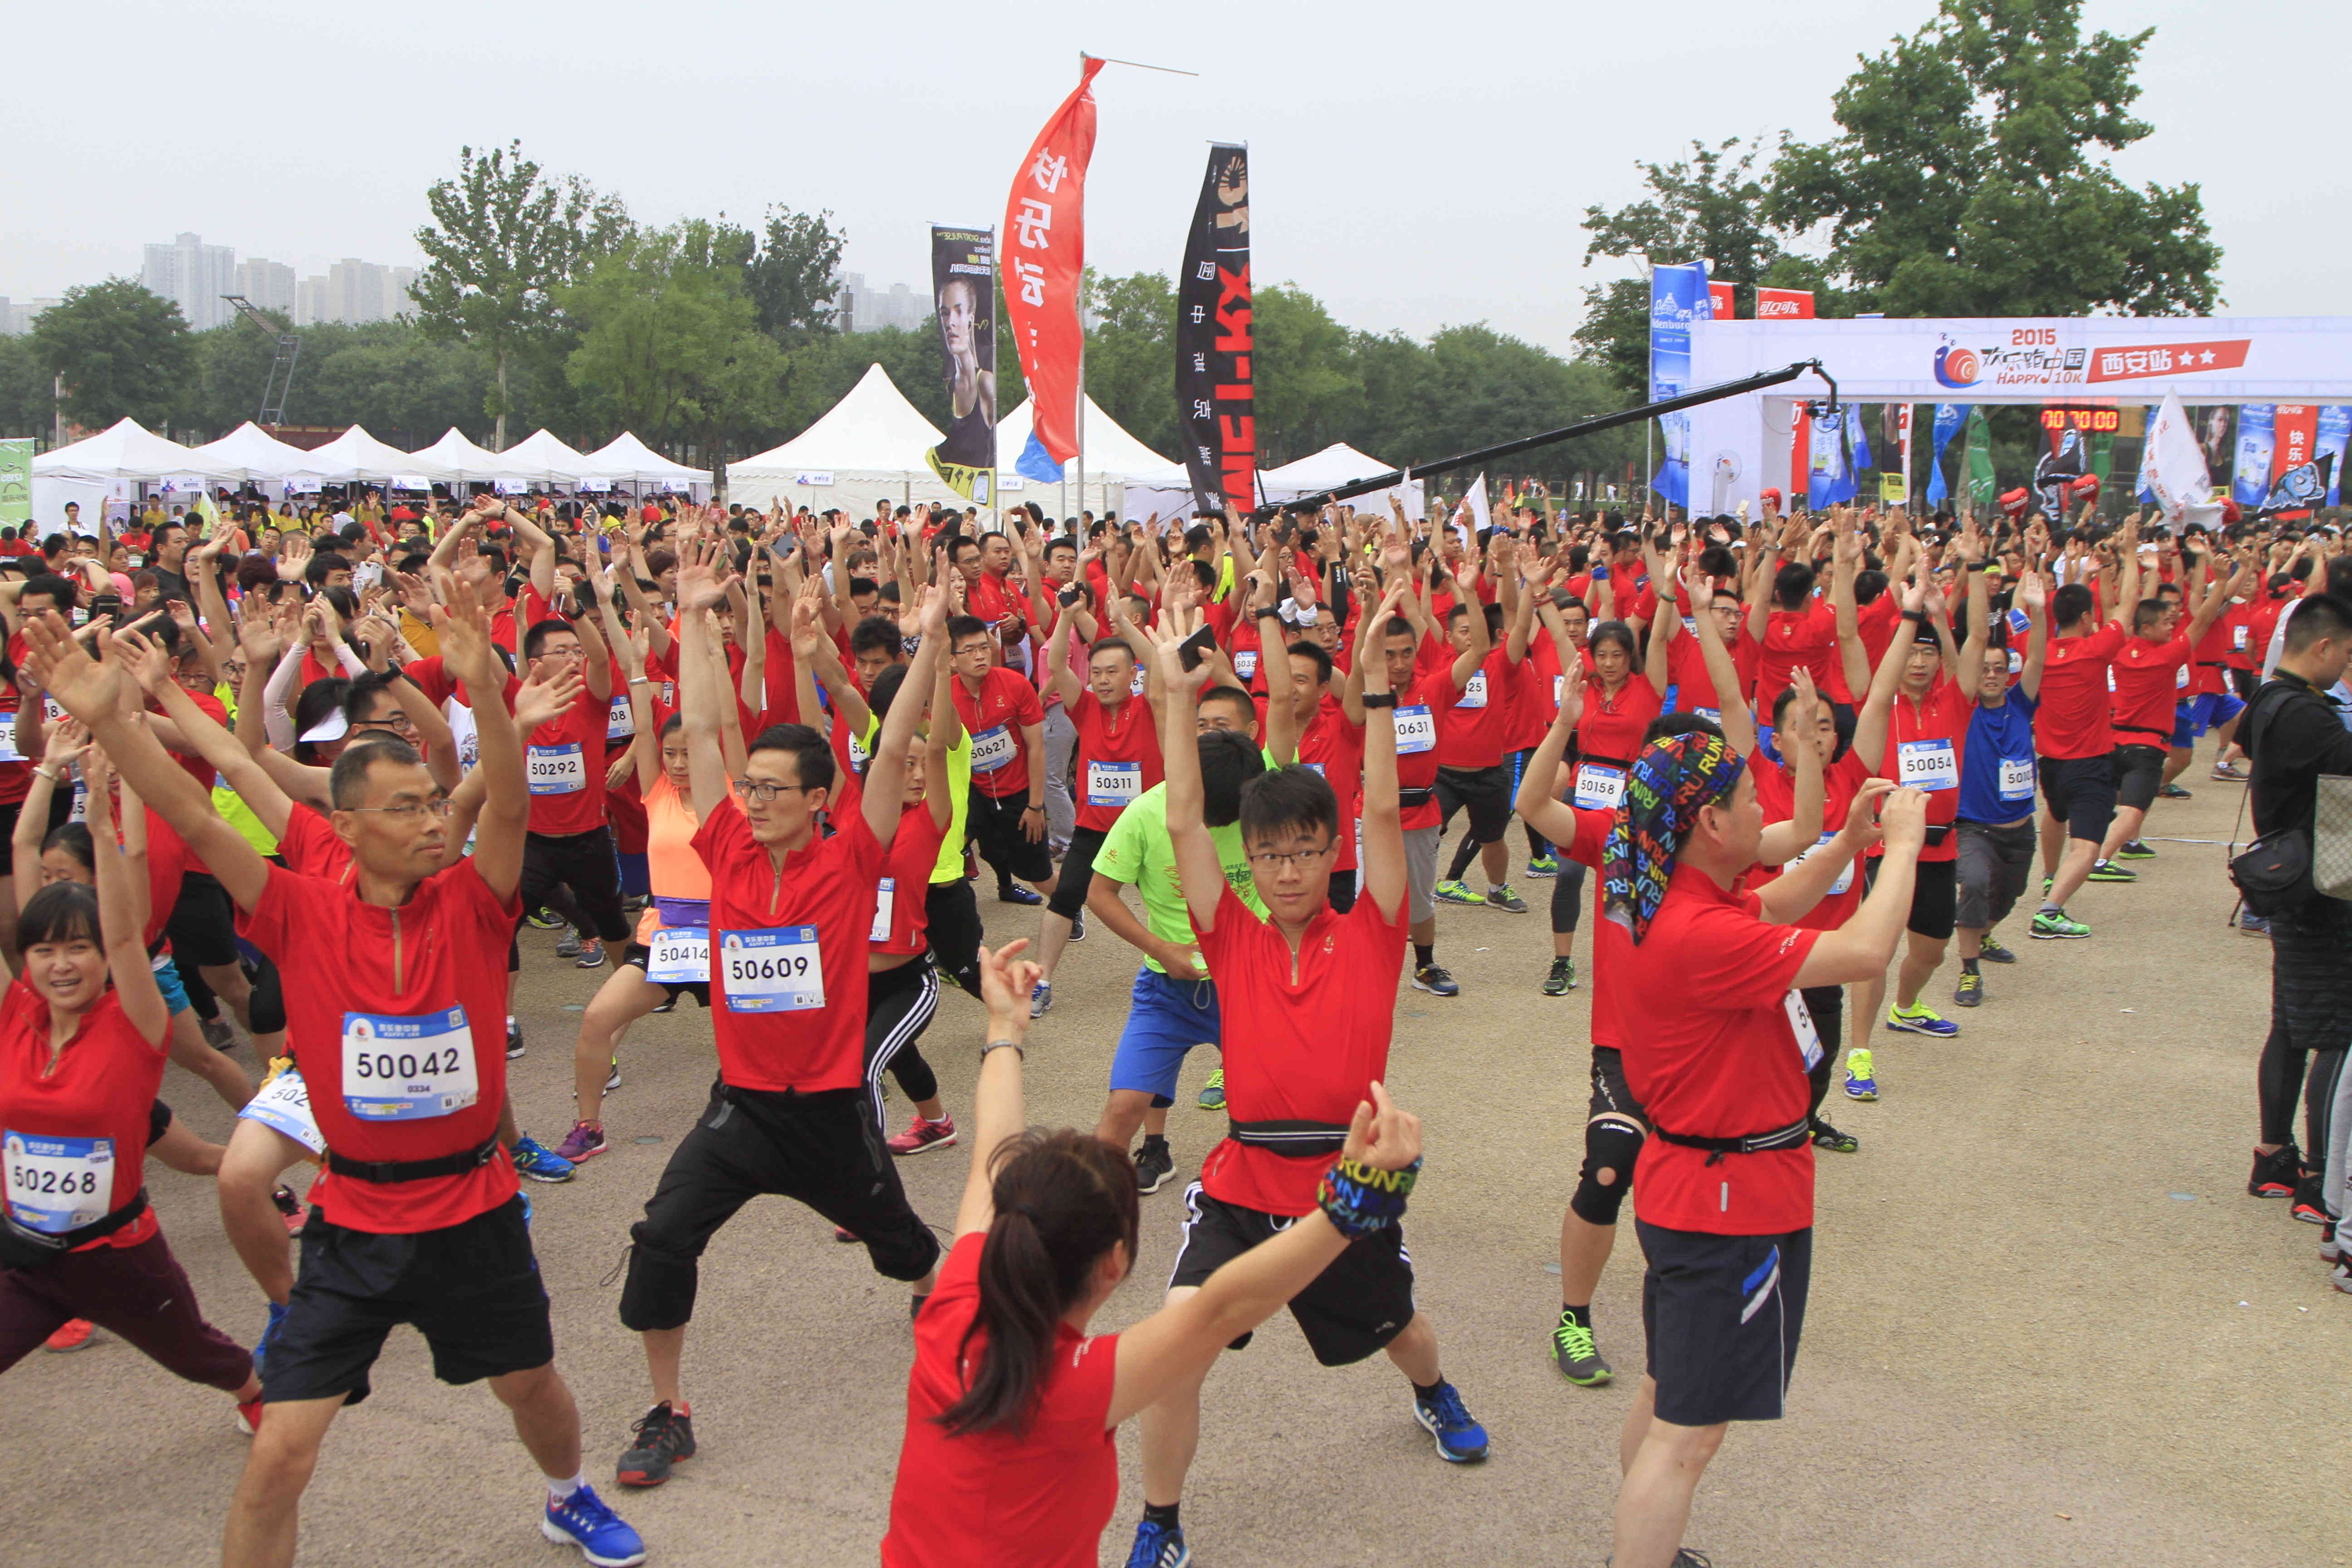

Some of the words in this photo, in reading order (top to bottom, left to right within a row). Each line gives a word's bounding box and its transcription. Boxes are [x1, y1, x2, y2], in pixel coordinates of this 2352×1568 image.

[1759, 300, 1800, 316] 可口可乐
[2012, 328, 2057, 345] 2015
[1980, 346, 2087, 371] 欢乐跑中国
[2102, 348, 2172, 375] 西安站
[1997, 372, 2042, 384] HAPPY
[2054, 371, 2083, 384] 10K
[1395, 721, 1429, 735] 0631
[1699, 741, 1724, 775] RUN
[1906, 756, 1952, 772] 50054
[532, 761, 577, 775] 50292
[1096, 777, 1131, 789] 50311
[1581, 779, 1615, 794] 50158
[660, 946, 709, 962] 50414
[733, 956, 808, 980] 50609
[357, 1047, 460, 1079] 50042
[15, 1165, 96, 1194] 50268
